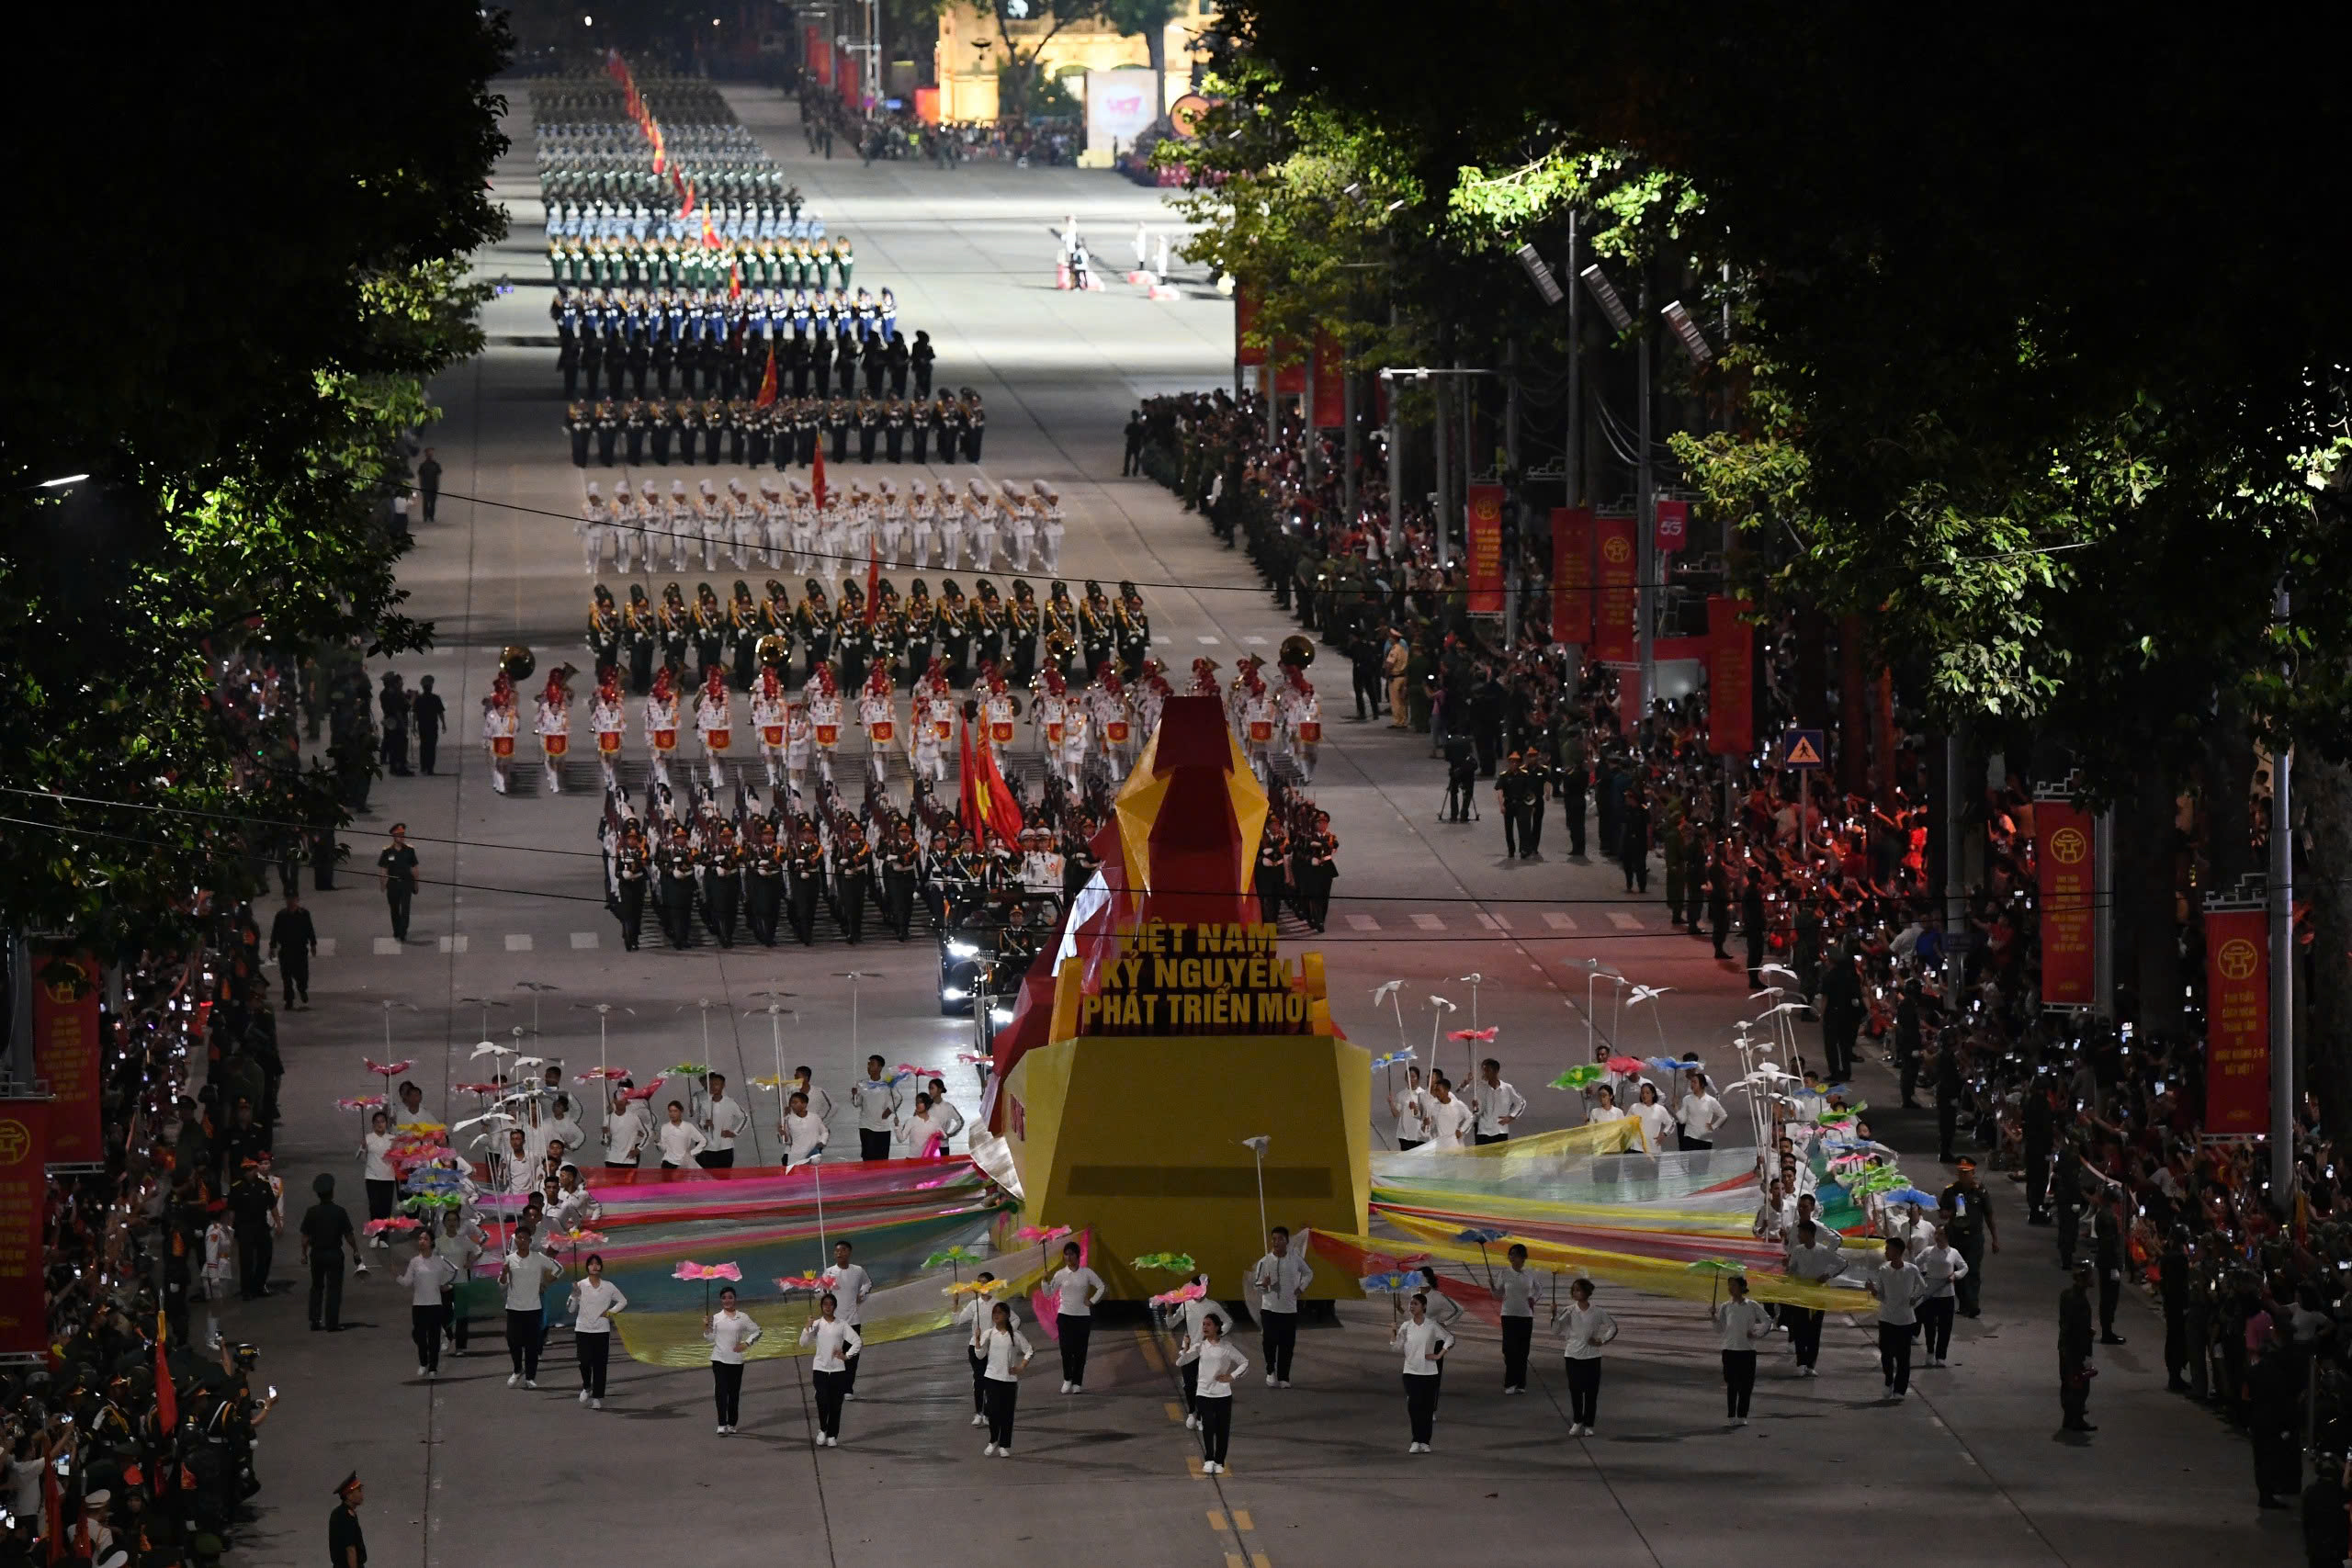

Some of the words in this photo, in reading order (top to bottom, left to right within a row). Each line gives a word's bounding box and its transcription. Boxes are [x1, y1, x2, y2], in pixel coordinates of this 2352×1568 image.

[1660, 521, 1682, 536] 5G
[1197, 922, 1278, 953] NAM
[1102, 950, 1143, 988] KỶ
[1154, 953, 1293, 988] NGUYÊN
[1084, 988, 1159, 1025] PHÁT
[1167, 983, 1250, 1024] TRIỂN
